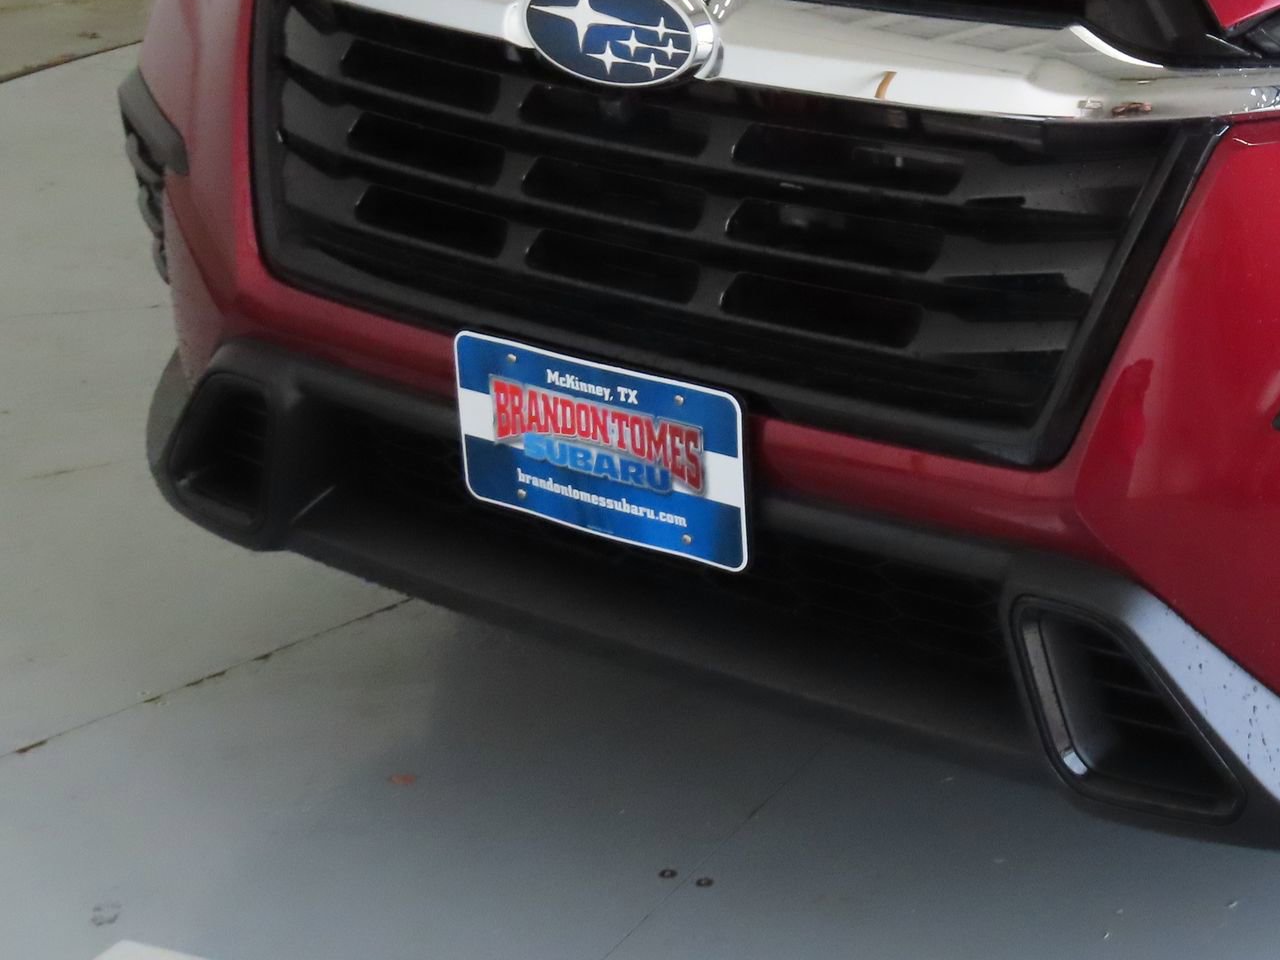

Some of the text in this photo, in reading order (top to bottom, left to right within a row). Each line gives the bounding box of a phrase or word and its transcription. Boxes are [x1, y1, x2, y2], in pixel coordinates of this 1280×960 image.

[546, 369, 639, 405] McKinney, TX
[493, 379, 702, 491] BRANDON TOMES
[524, 433, 673, 493] SUBARU
[517, 468, 688, 528] brandontomessubaru.com
